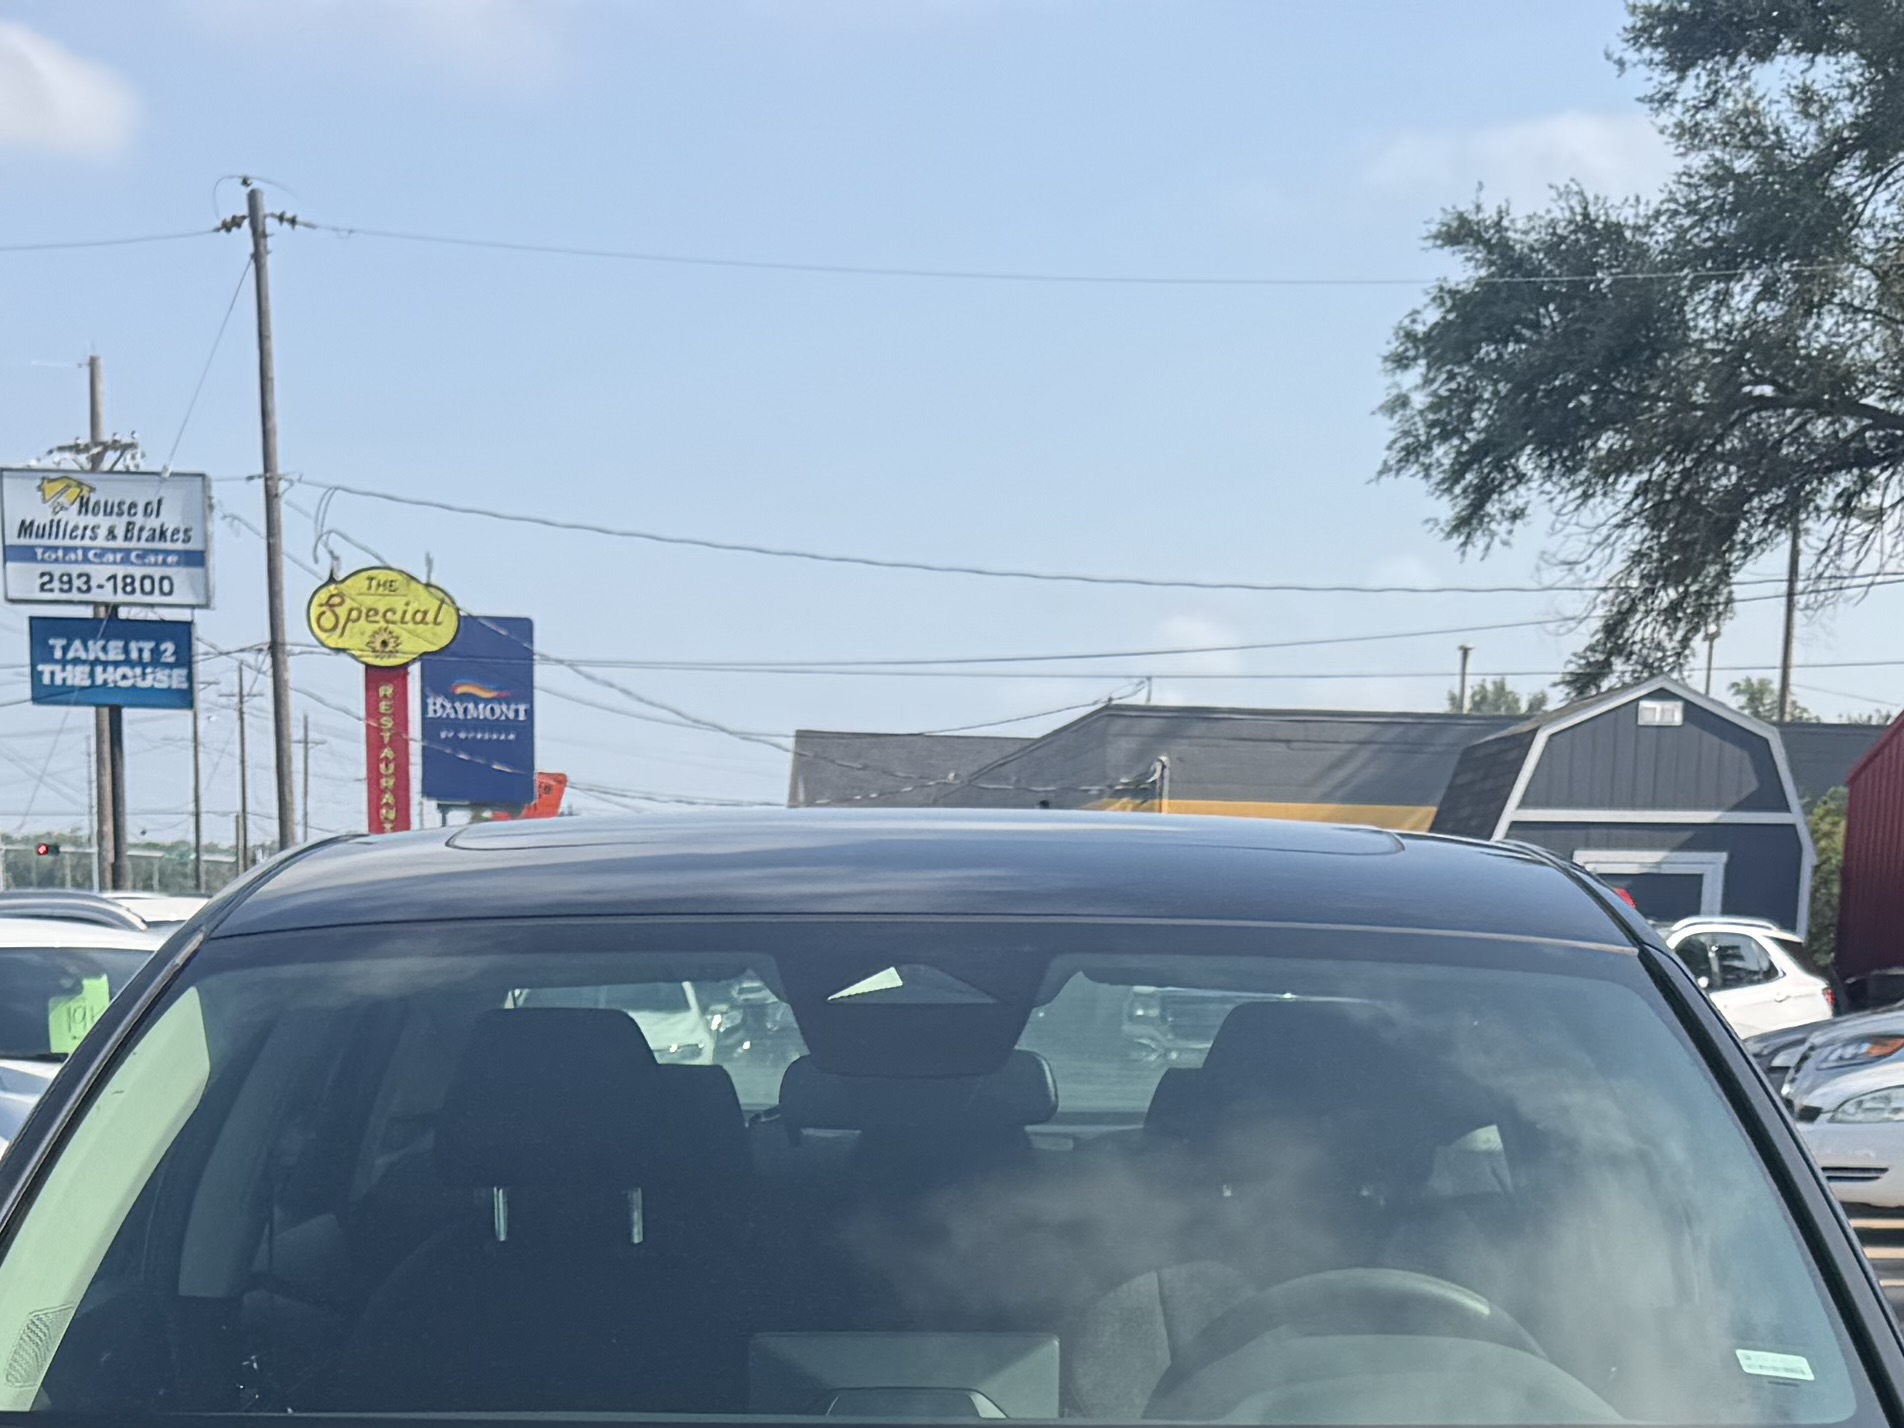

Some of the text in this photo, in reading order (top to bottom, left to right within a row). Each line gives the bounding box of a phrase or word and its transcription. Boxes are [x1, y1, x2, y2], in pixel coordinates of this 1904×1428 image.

[77, 495, 164, 518] House of
[104, 524, 118, 542] &
[123, 520, 193, 544] Brakes
[34, 547, 179, 566] Total Car Care
[38, 571, 175, 597] 293-1800
[365, 576, 399, 593] THE
[316, 592, 446, 639] Special
[48, 638, 177, 663] TAKE IT 2
[37, 663, 190, 690] THE HOUSE
[424, 694, 530, 721] BAYMONT
